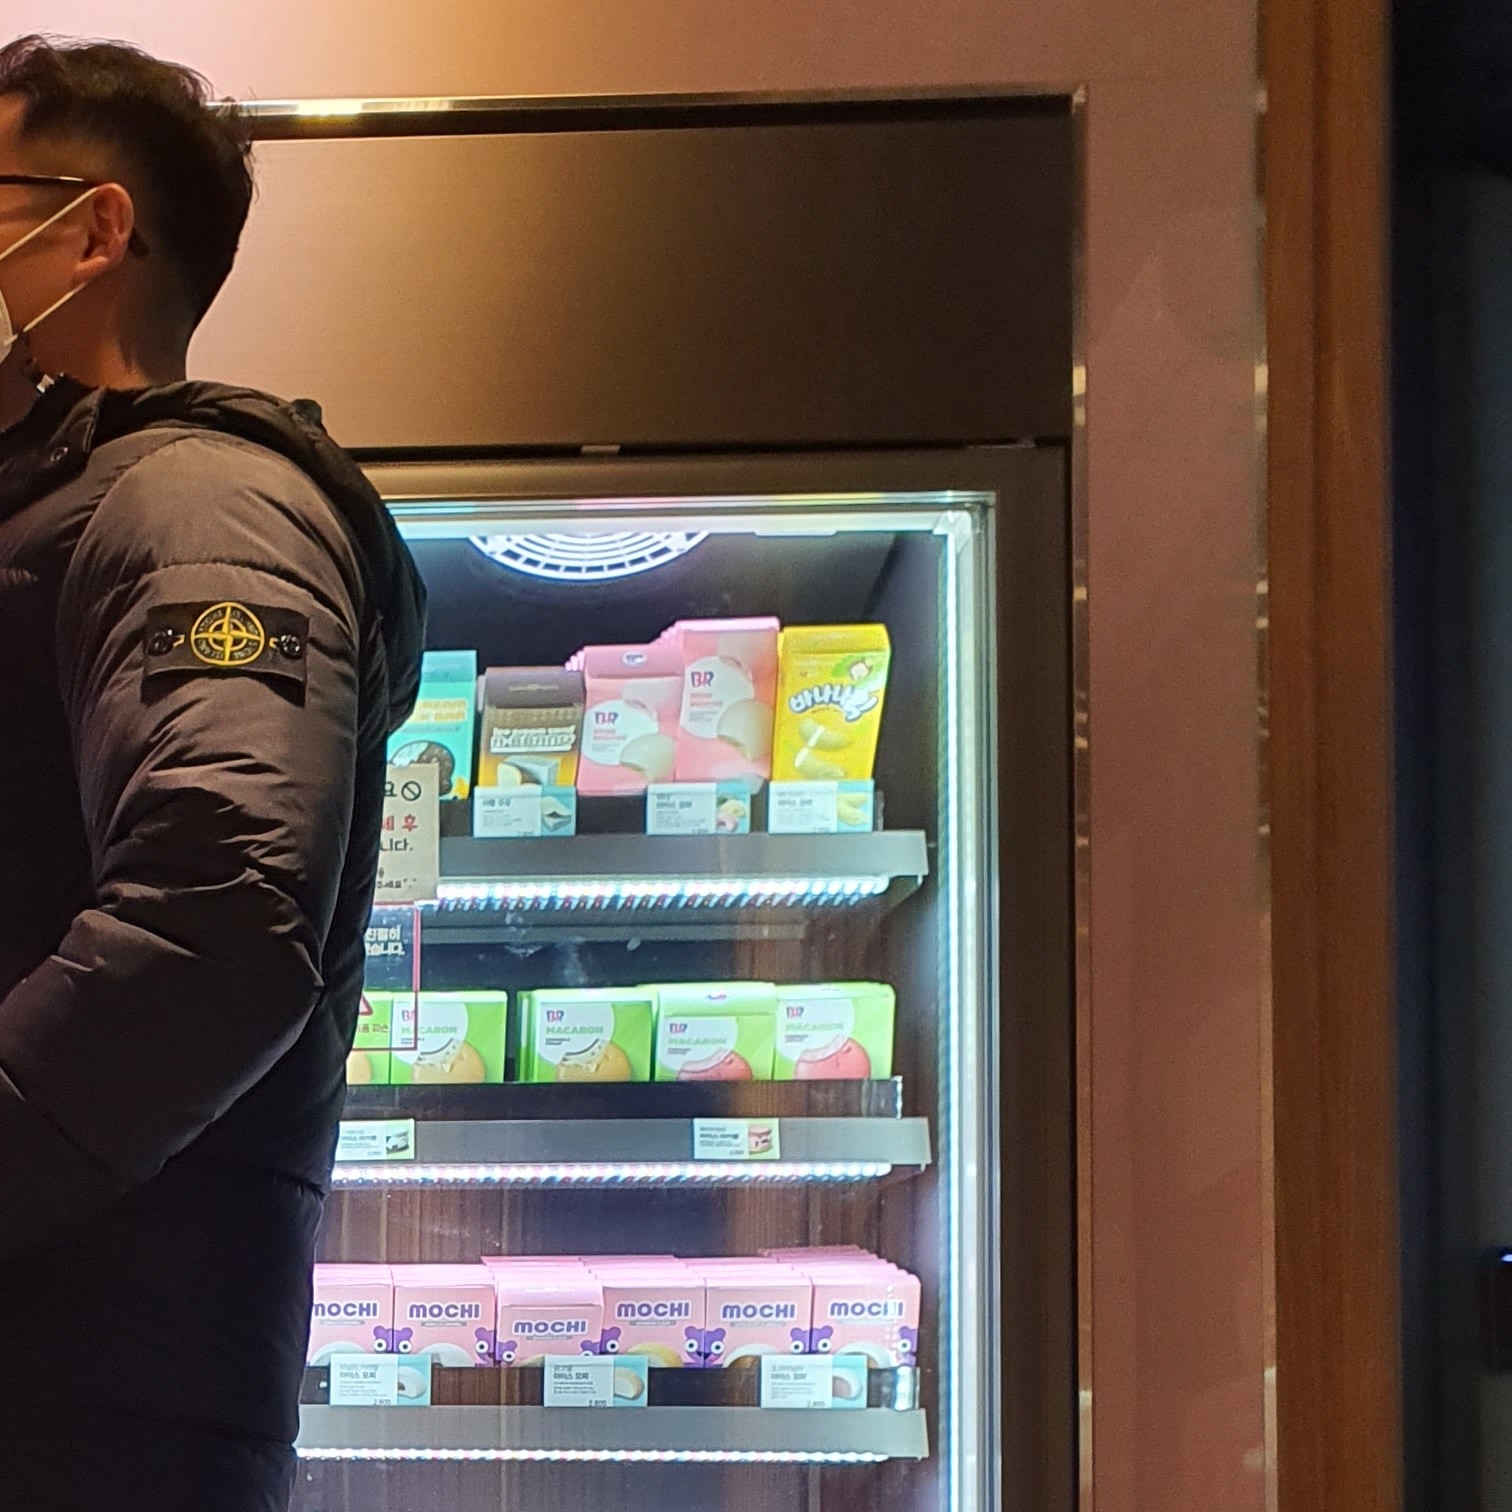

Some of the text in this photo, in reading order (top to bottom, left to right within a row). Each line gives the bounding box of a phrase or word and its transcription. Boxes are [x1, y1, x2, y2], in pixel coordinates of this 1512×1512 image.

[691, 671, 714, 688] BR
[402, 813, 418, 833] 후
[546, 1026, 604, 1035] MACARON
[408, 1303, 481, 1319] MOCHI
[617, 1302, 690, 1318] MOCHI
[722, 1303, 796, 1319] MOCHI
[513, 1320, 587, 1334] MOCHI
